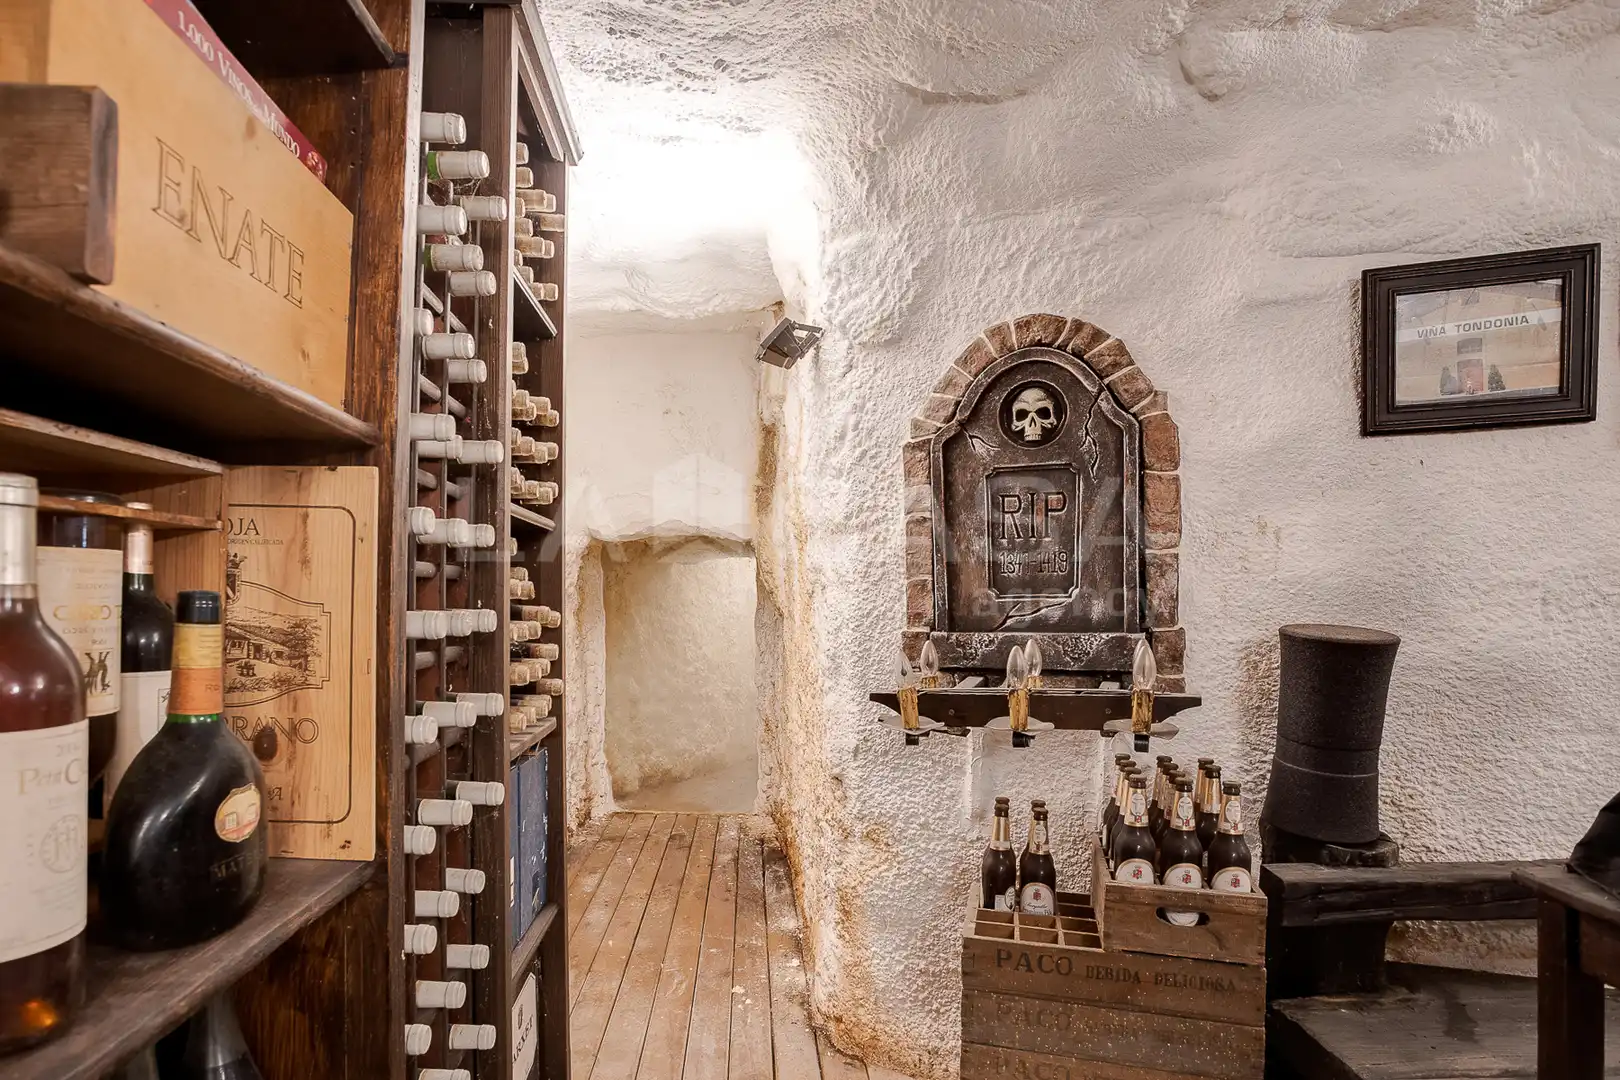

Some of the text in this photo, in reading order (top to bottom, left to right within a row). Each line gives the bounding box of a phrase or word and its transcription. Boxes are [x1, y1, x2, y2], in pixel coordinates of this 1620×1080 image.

[151, 136, 304, 310] ENATE
[1454, 315, 1530, 334] TONDONIA
[998, 492, 1067, 540] RIP
[995, 948, 1073, 977] PACO
